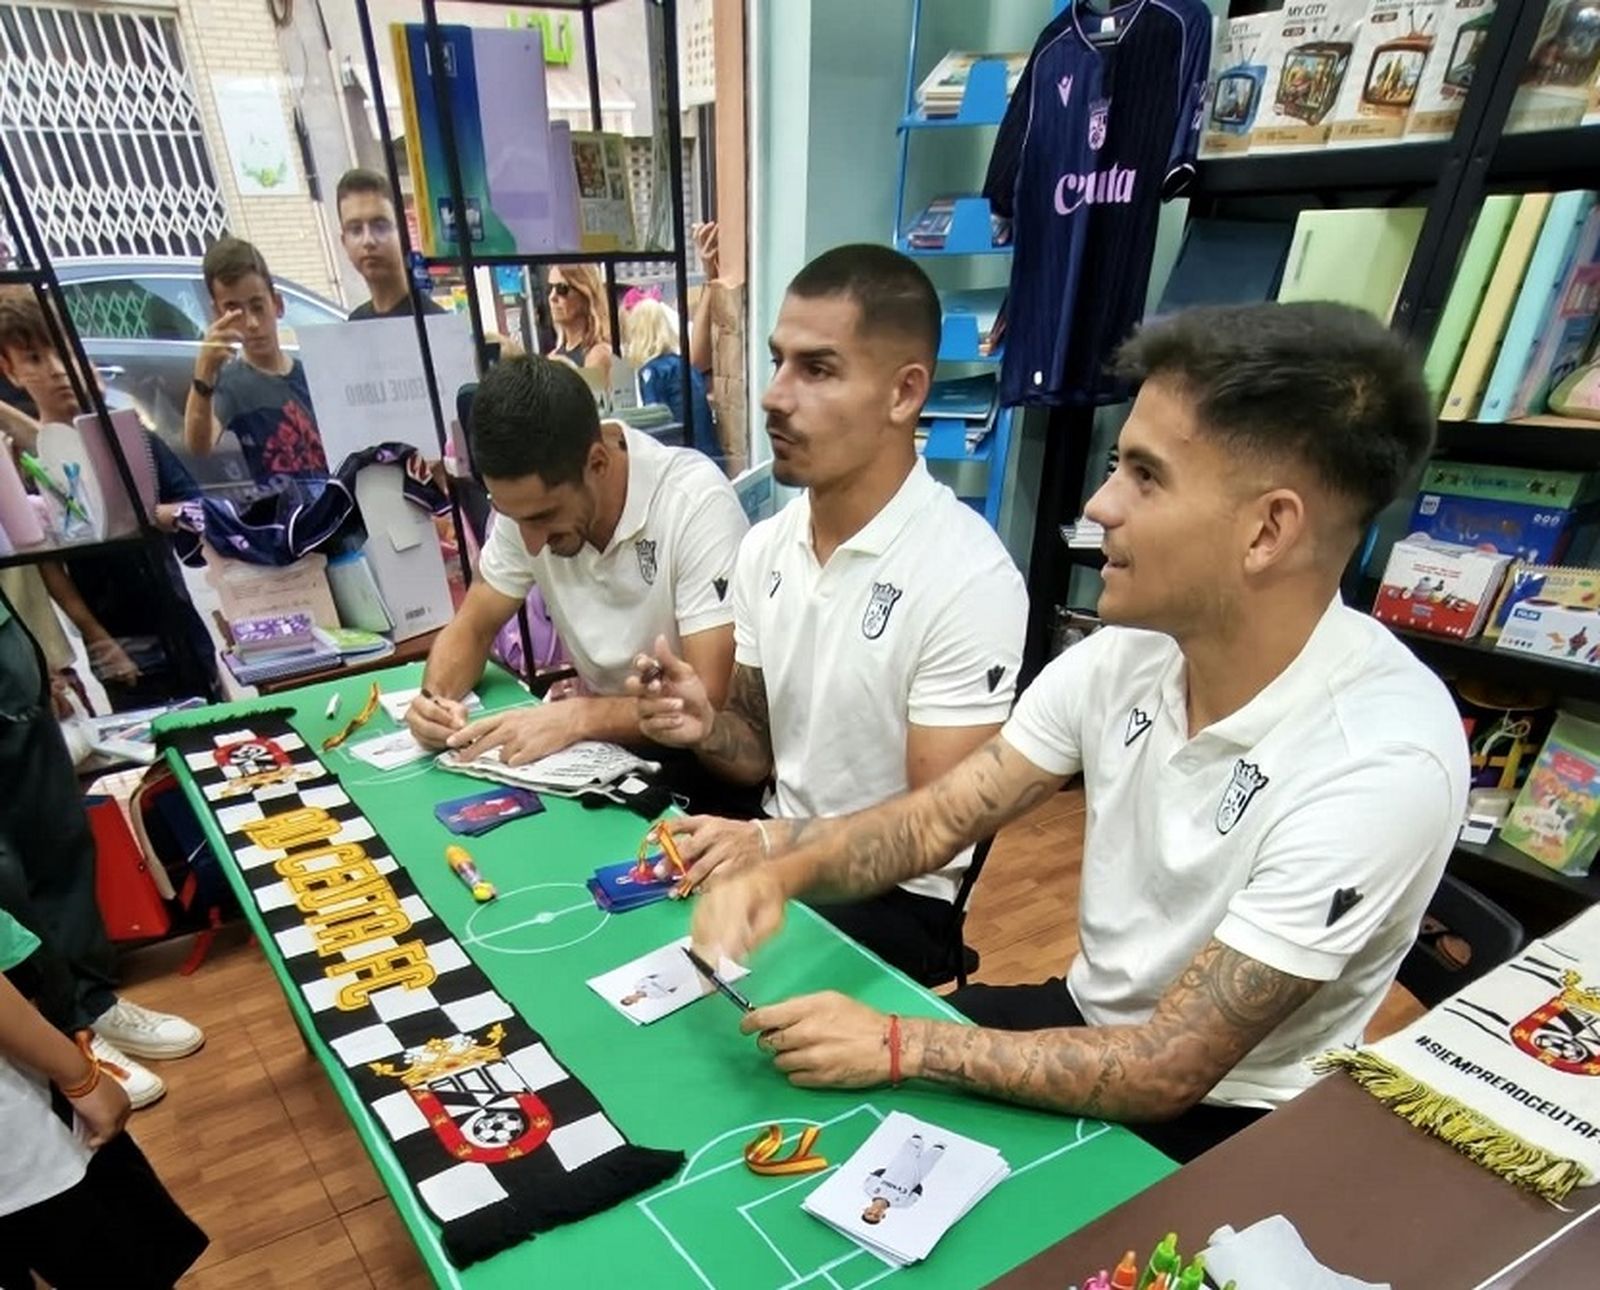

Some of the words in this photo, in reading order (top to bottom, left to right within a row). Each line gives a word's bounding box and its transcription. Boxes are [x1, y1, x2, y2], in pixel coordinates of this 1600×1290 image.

[1287, 6, 1303, 17] MY
[1304, 3, 1328, 16] CITY
[274, 841, 412, 957] CEUTA
[325, 938, 438, 1012] FC
[1415, 1034, 1600, 1144] #SIEMPREADCEUTAF
